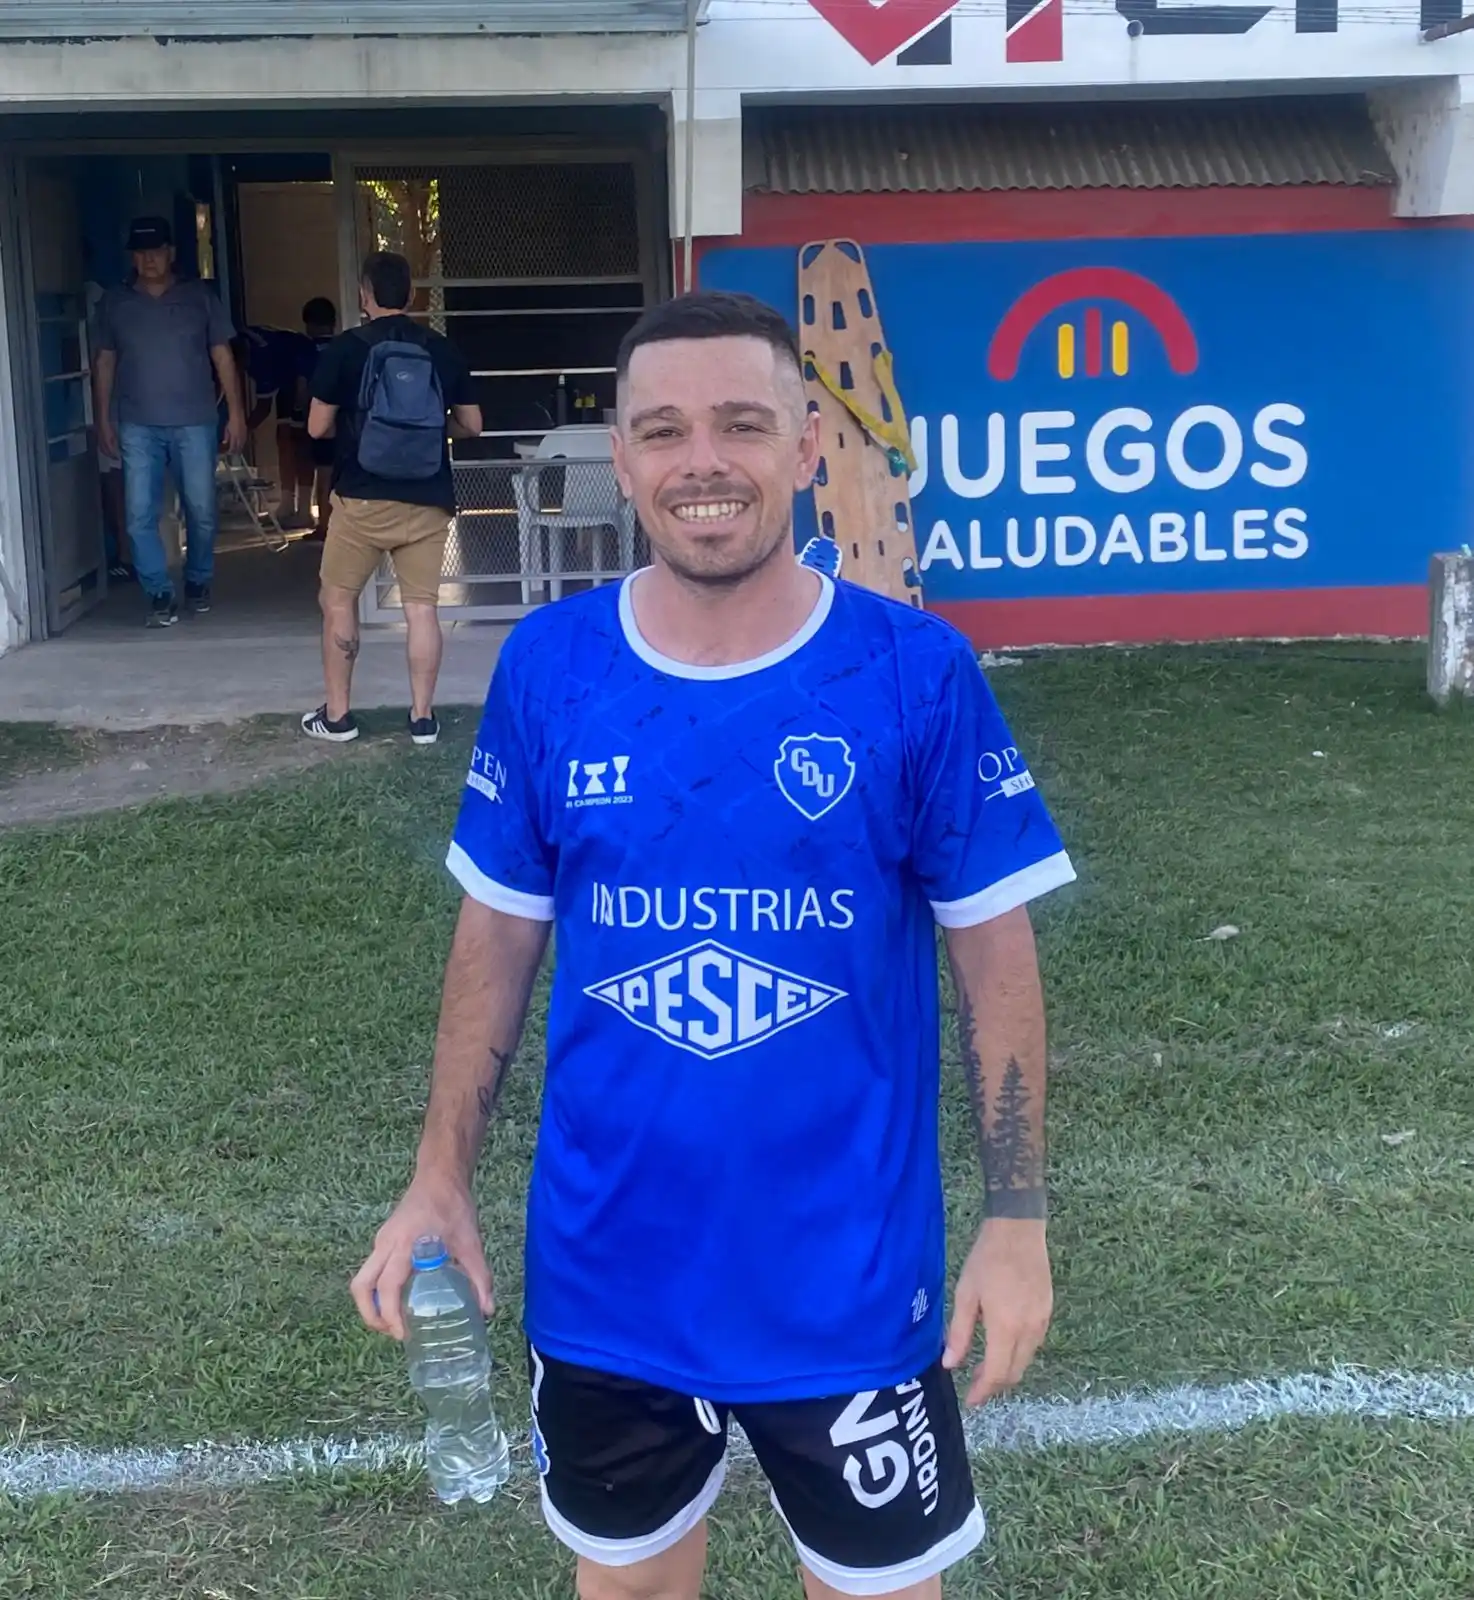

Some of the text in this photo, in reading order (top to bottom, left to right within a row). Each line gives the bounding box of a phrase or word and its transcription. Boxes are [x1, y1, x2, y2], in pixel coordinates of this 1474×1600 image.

[907, 403, 1309, 499] JUEGOS
[918, 507, 1310, 572] ALUDABLES
[470, 745, 507, 789] PEN
[790, 747, 835, 798] CDU
[977, 746, 1019, 783] OP
[592, 882, 854, 931] INDUSTRIAS
[622, 948, 807, 1050] PESCE
